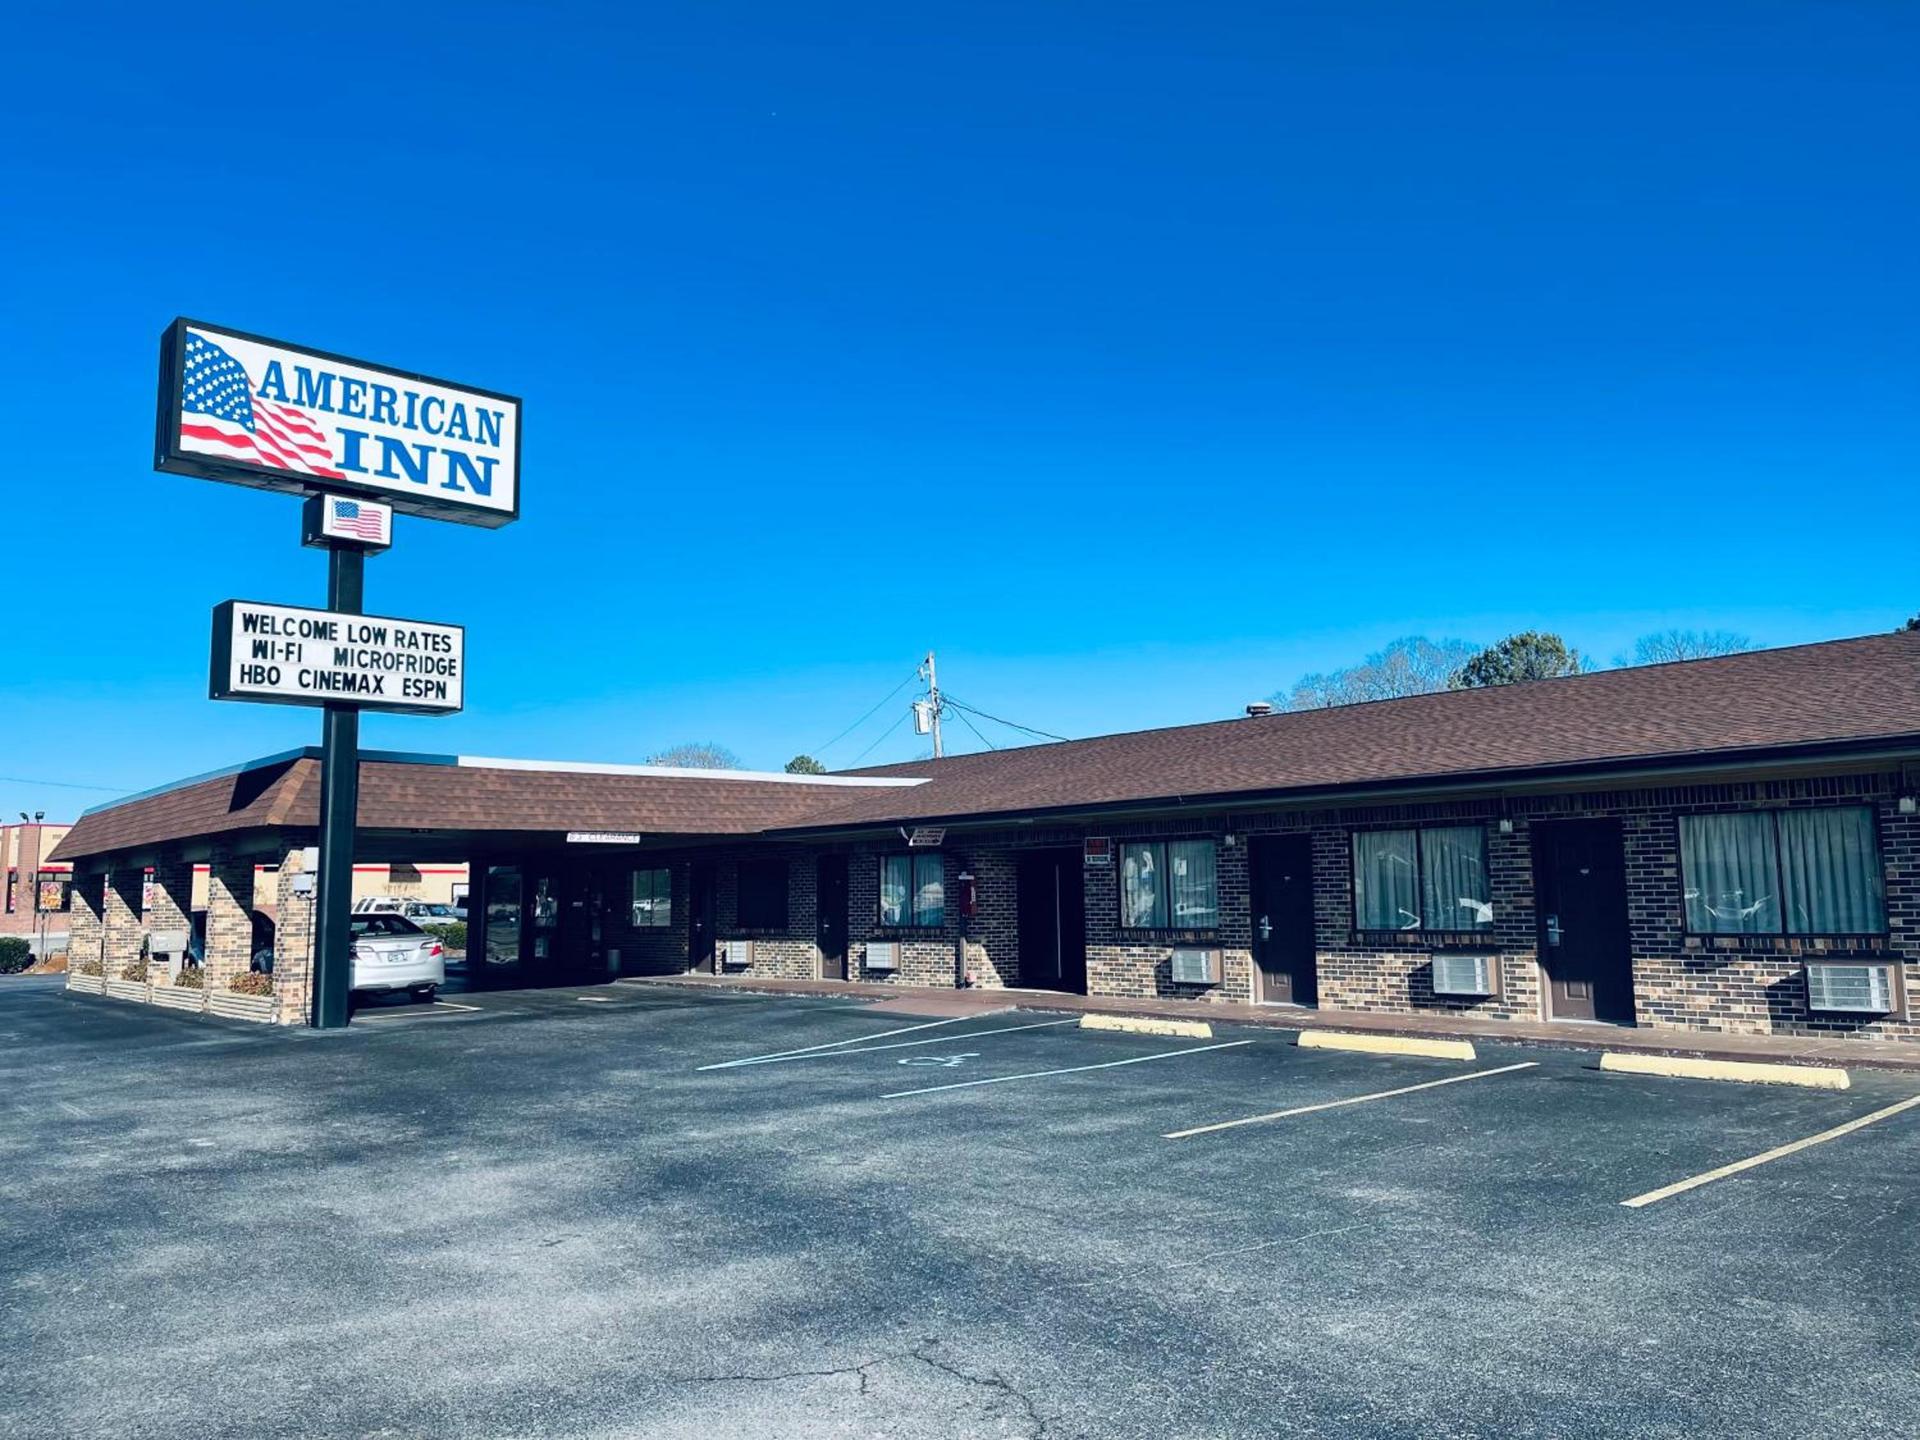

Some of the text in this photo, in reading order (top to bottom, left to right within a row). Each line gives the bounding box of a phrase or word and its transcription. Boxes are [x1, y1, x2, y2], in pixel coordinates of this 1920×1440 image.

[257, 360, 505, 448] AMERICAN
[335, 427, 500, 497] INN
[242, 612, 452, 653] WELCOME LOW RATES
[252, 639, 457, 677] WI-FI MICROFRIDGE
[240, 664, 447, 699] HBO CINEMAX ESPN
